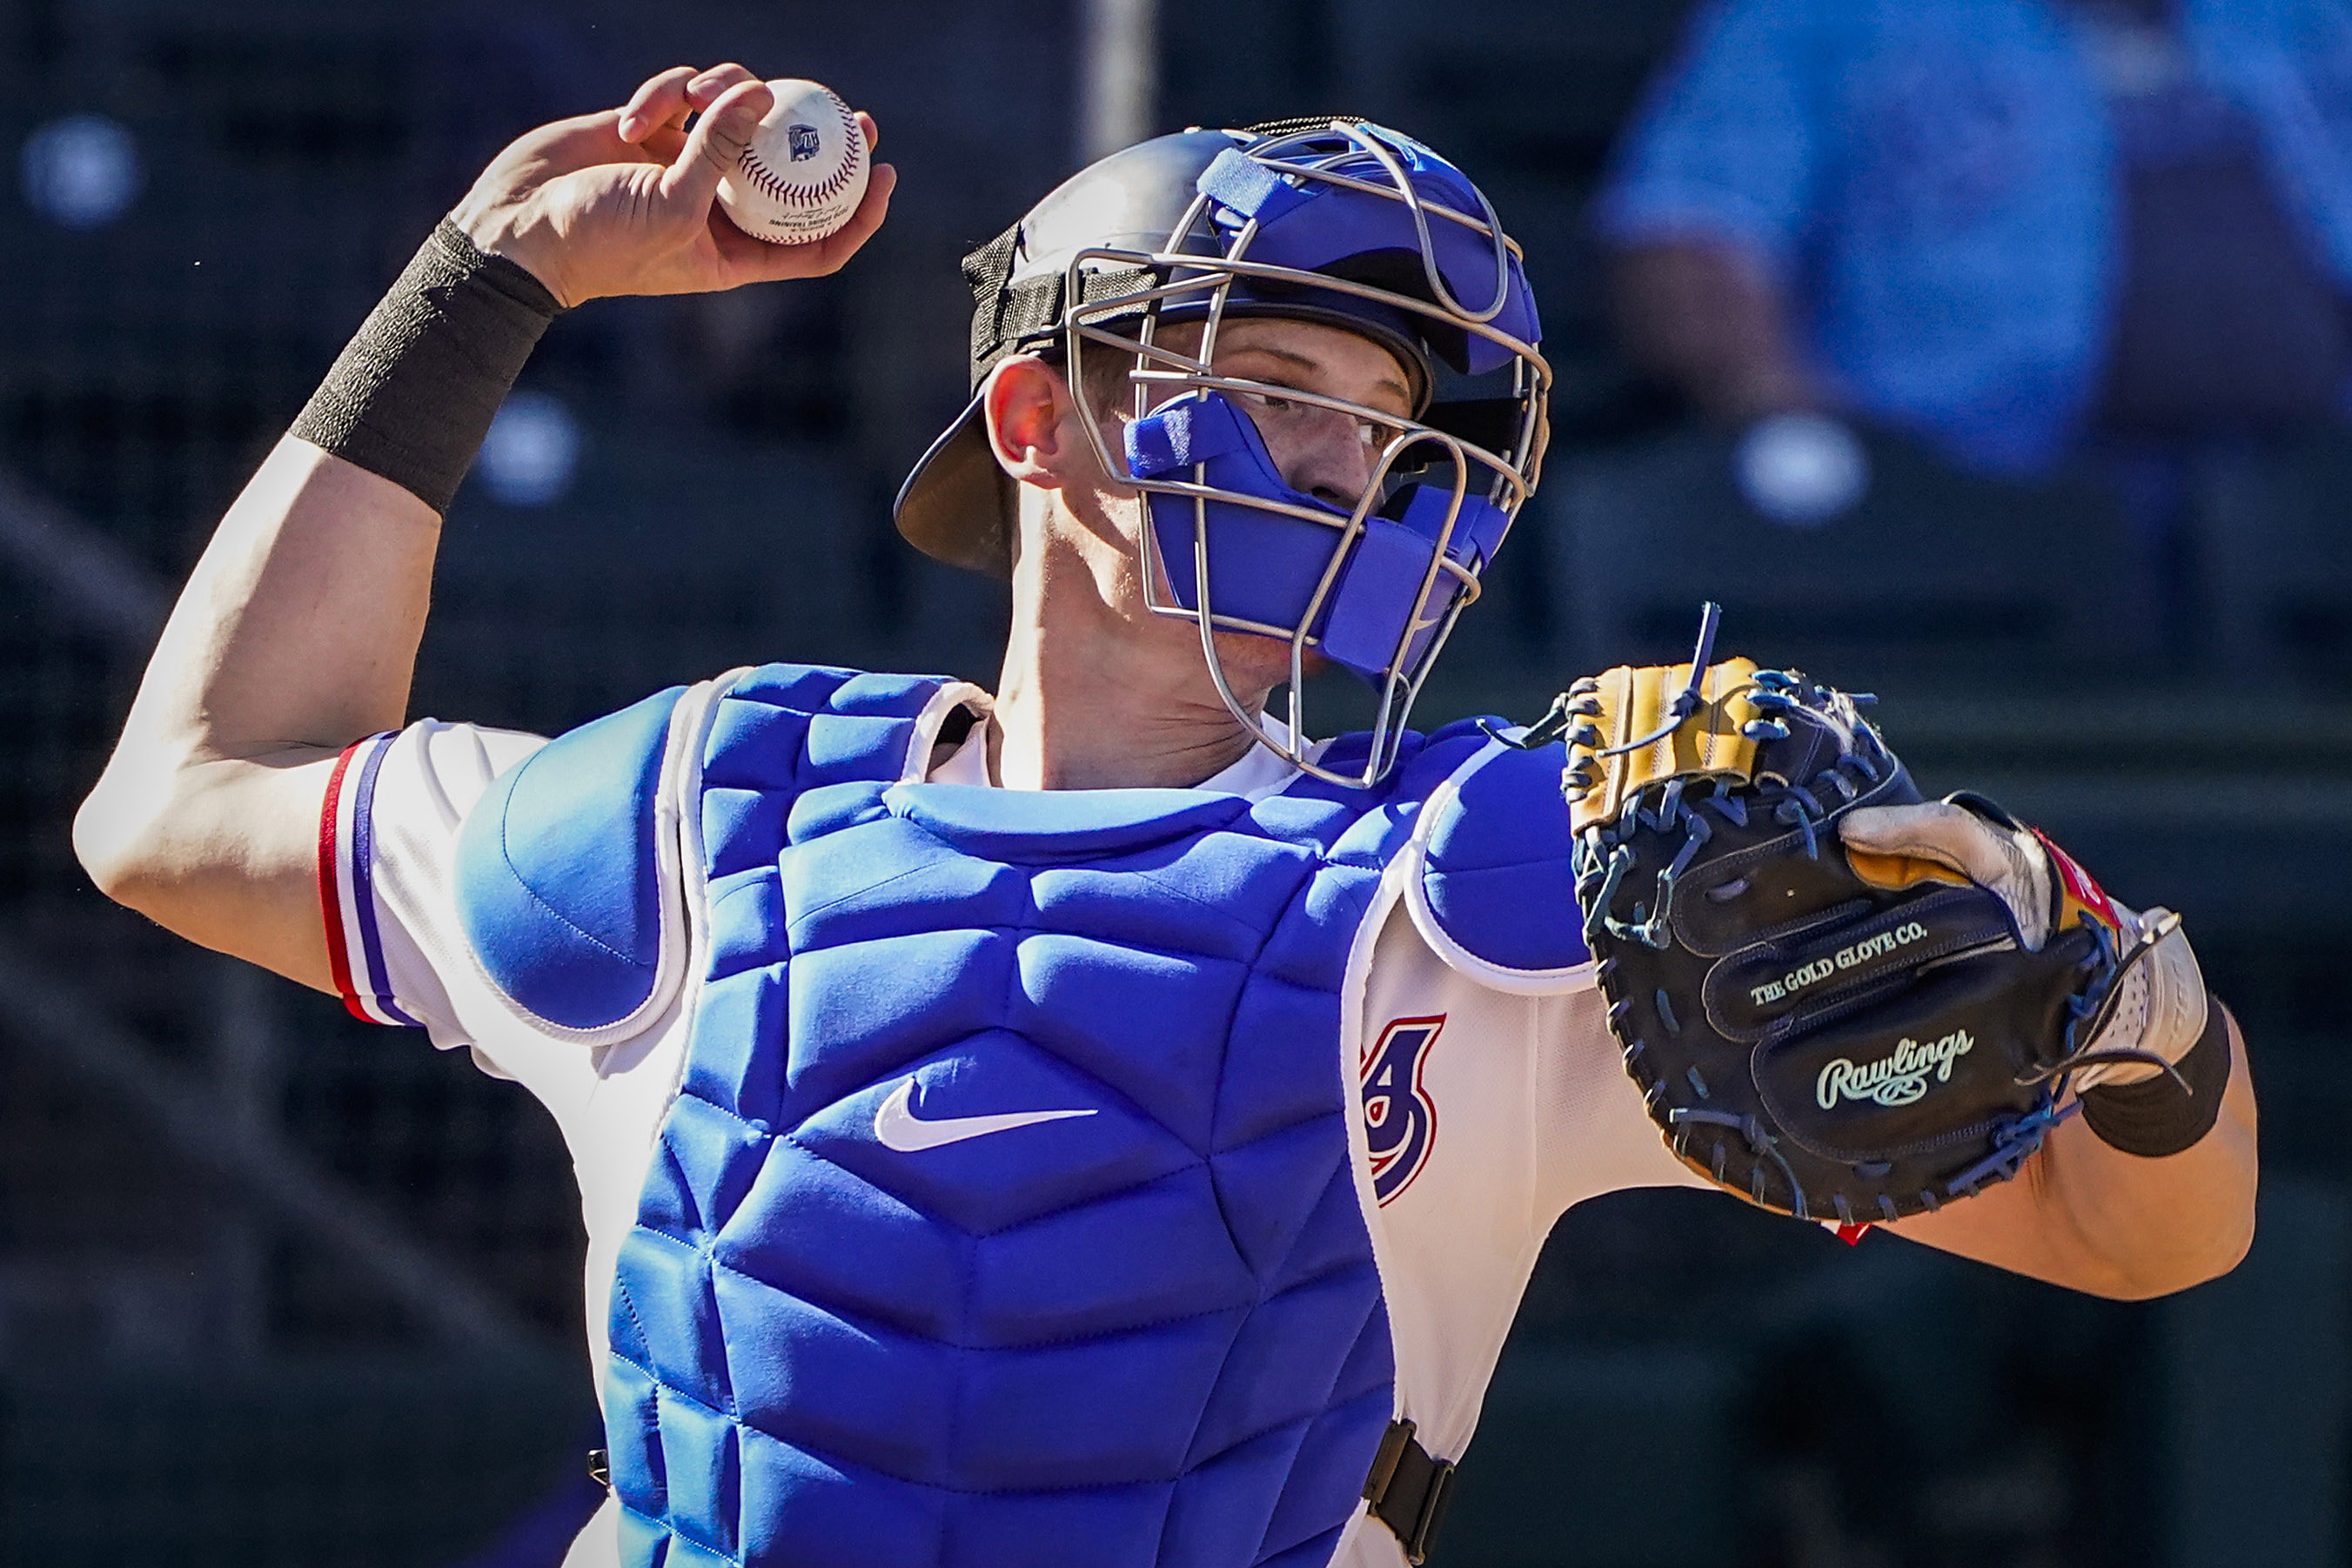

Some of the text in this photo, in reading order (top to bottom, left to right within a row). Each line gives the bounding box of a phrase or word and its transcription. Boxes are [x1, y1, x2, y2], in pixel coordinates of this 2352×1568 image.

[1751, 921, 1928, 1006] THE GOLD GLOVE CO.
[1816, 1029, 1974, 1109] Rawlings
